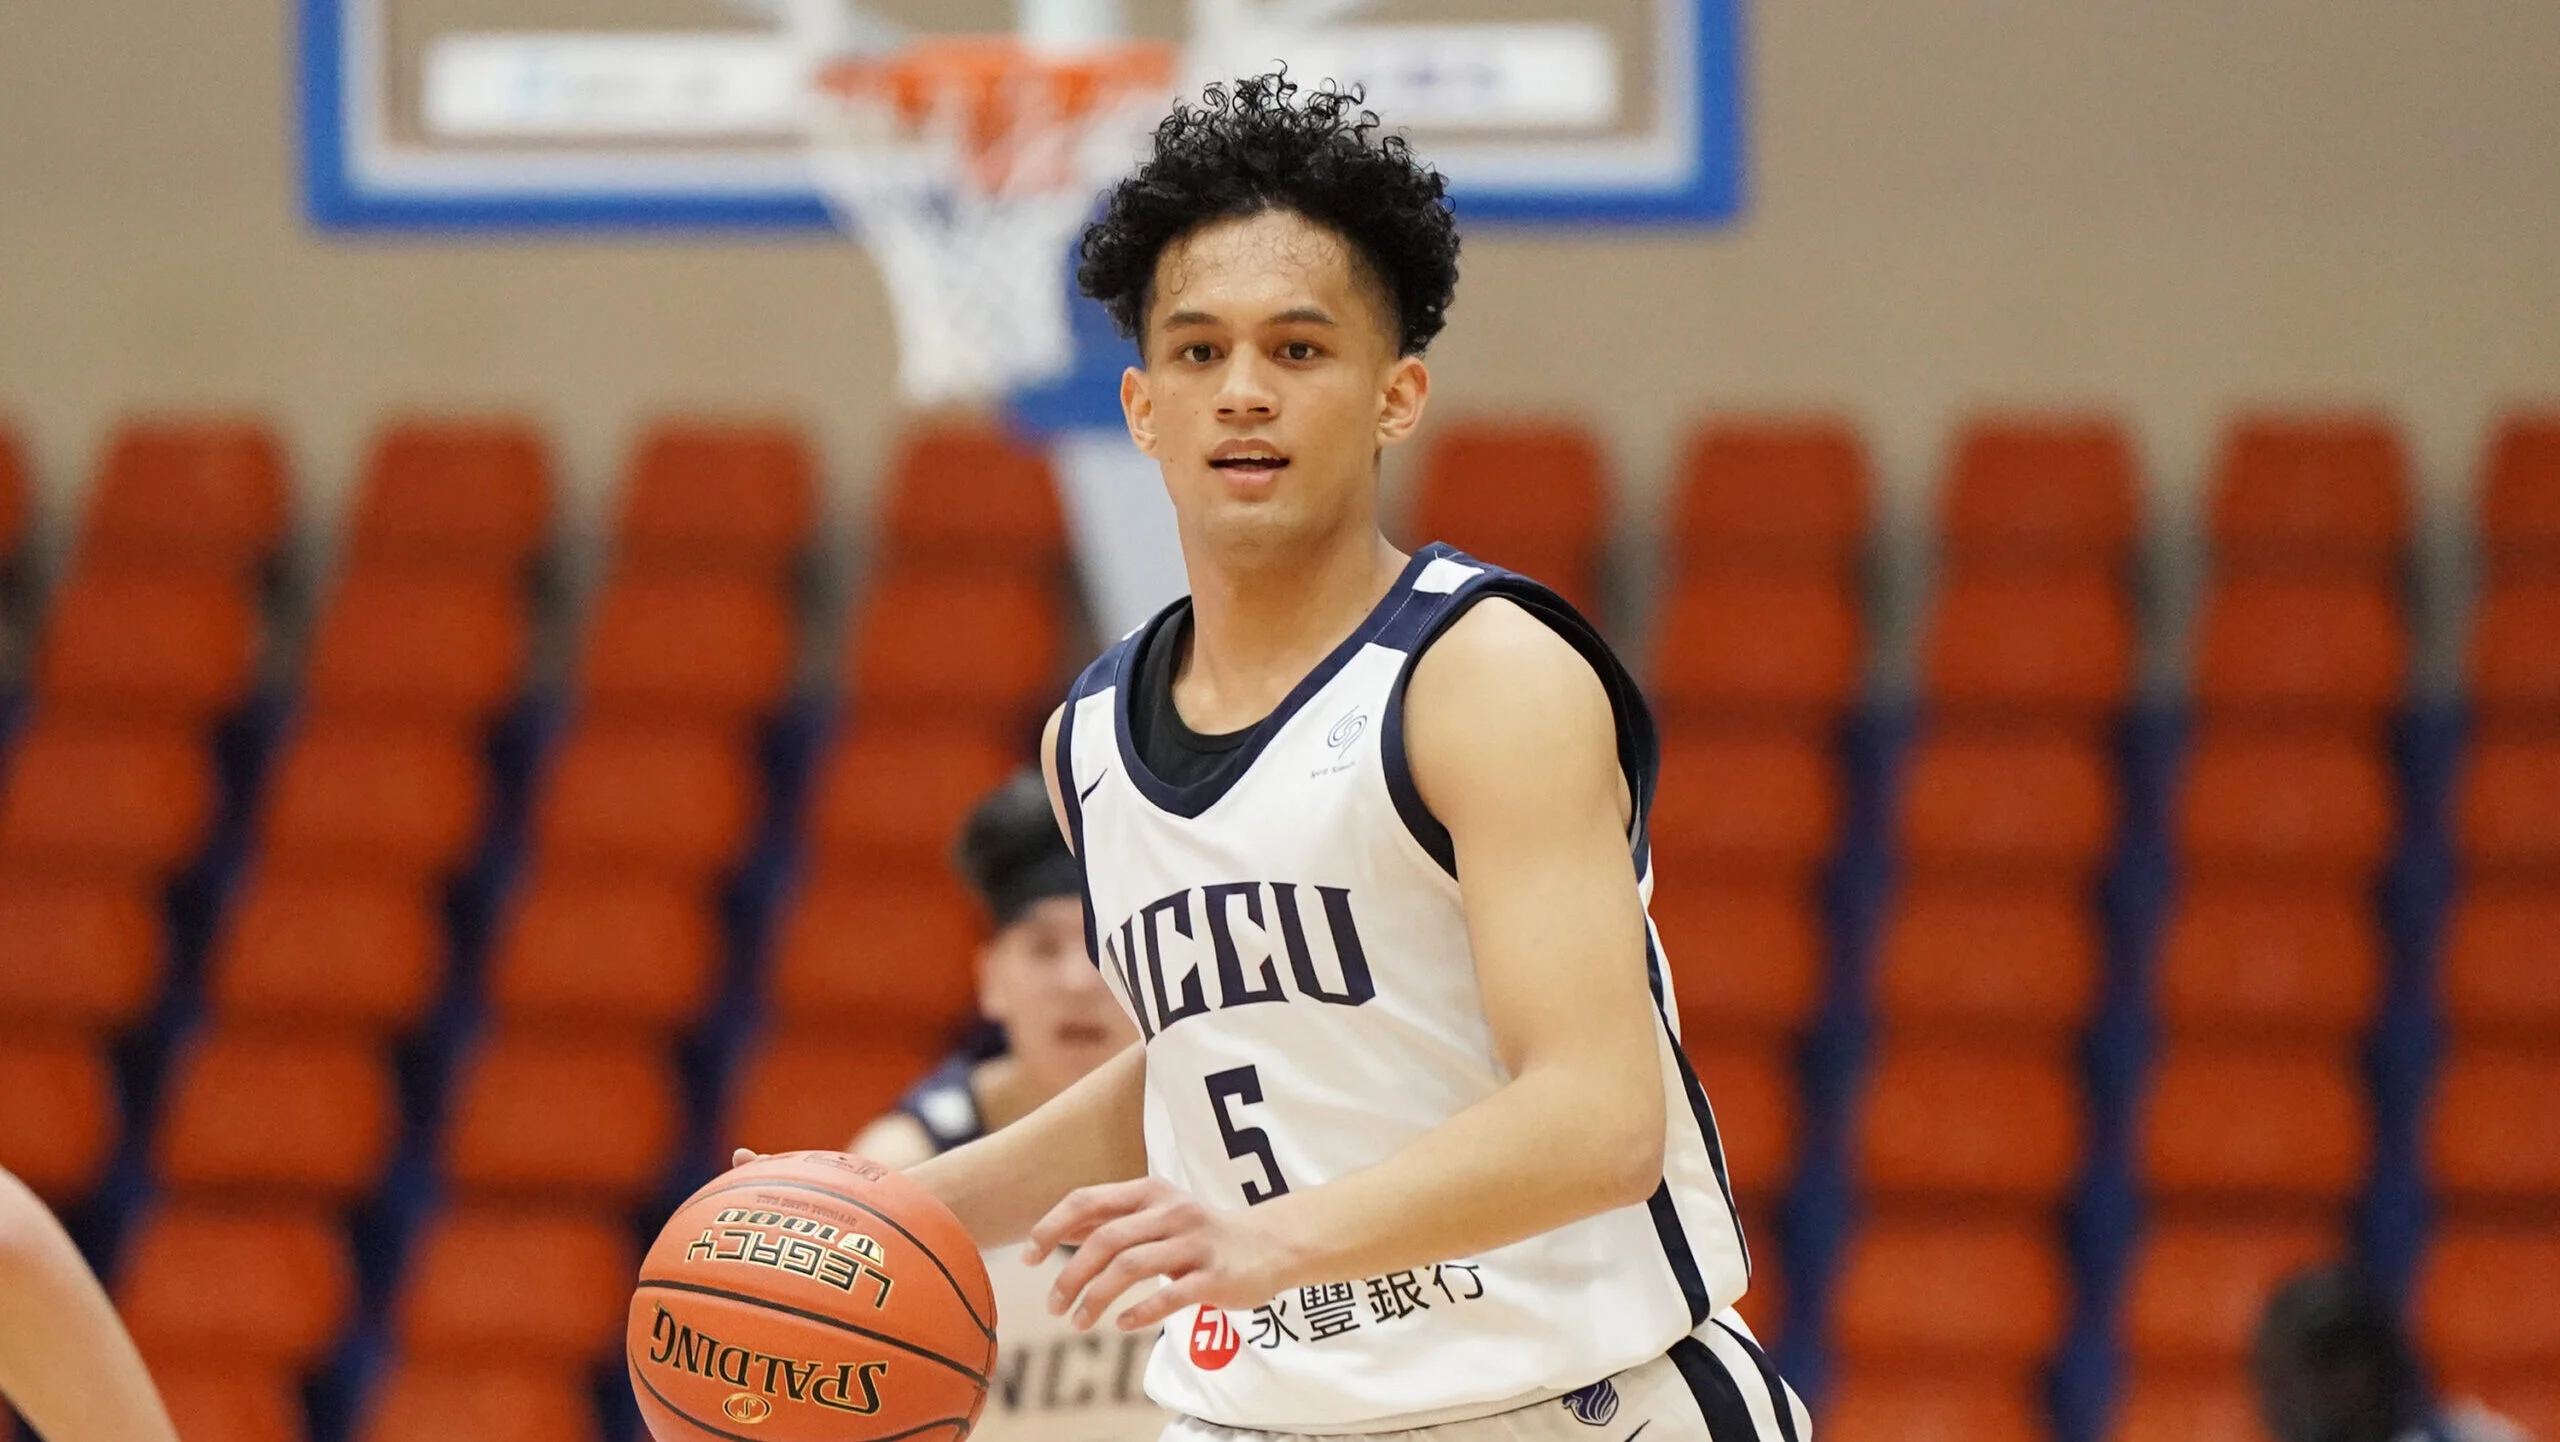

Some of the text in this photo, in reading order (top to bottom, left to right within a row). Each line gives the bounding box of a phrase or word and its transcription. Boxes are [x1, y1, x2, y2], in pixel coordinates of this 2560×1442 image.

[1105, 881, 1376, 1046] NCCU
[1204, 1064, 1290, 1207] 5
[685, 1229, 894, 1311] LEGACY
[1247, 1264, 1484, 1349] 永豐銀行
[650, 1304, 888, 1416] SPALDING
